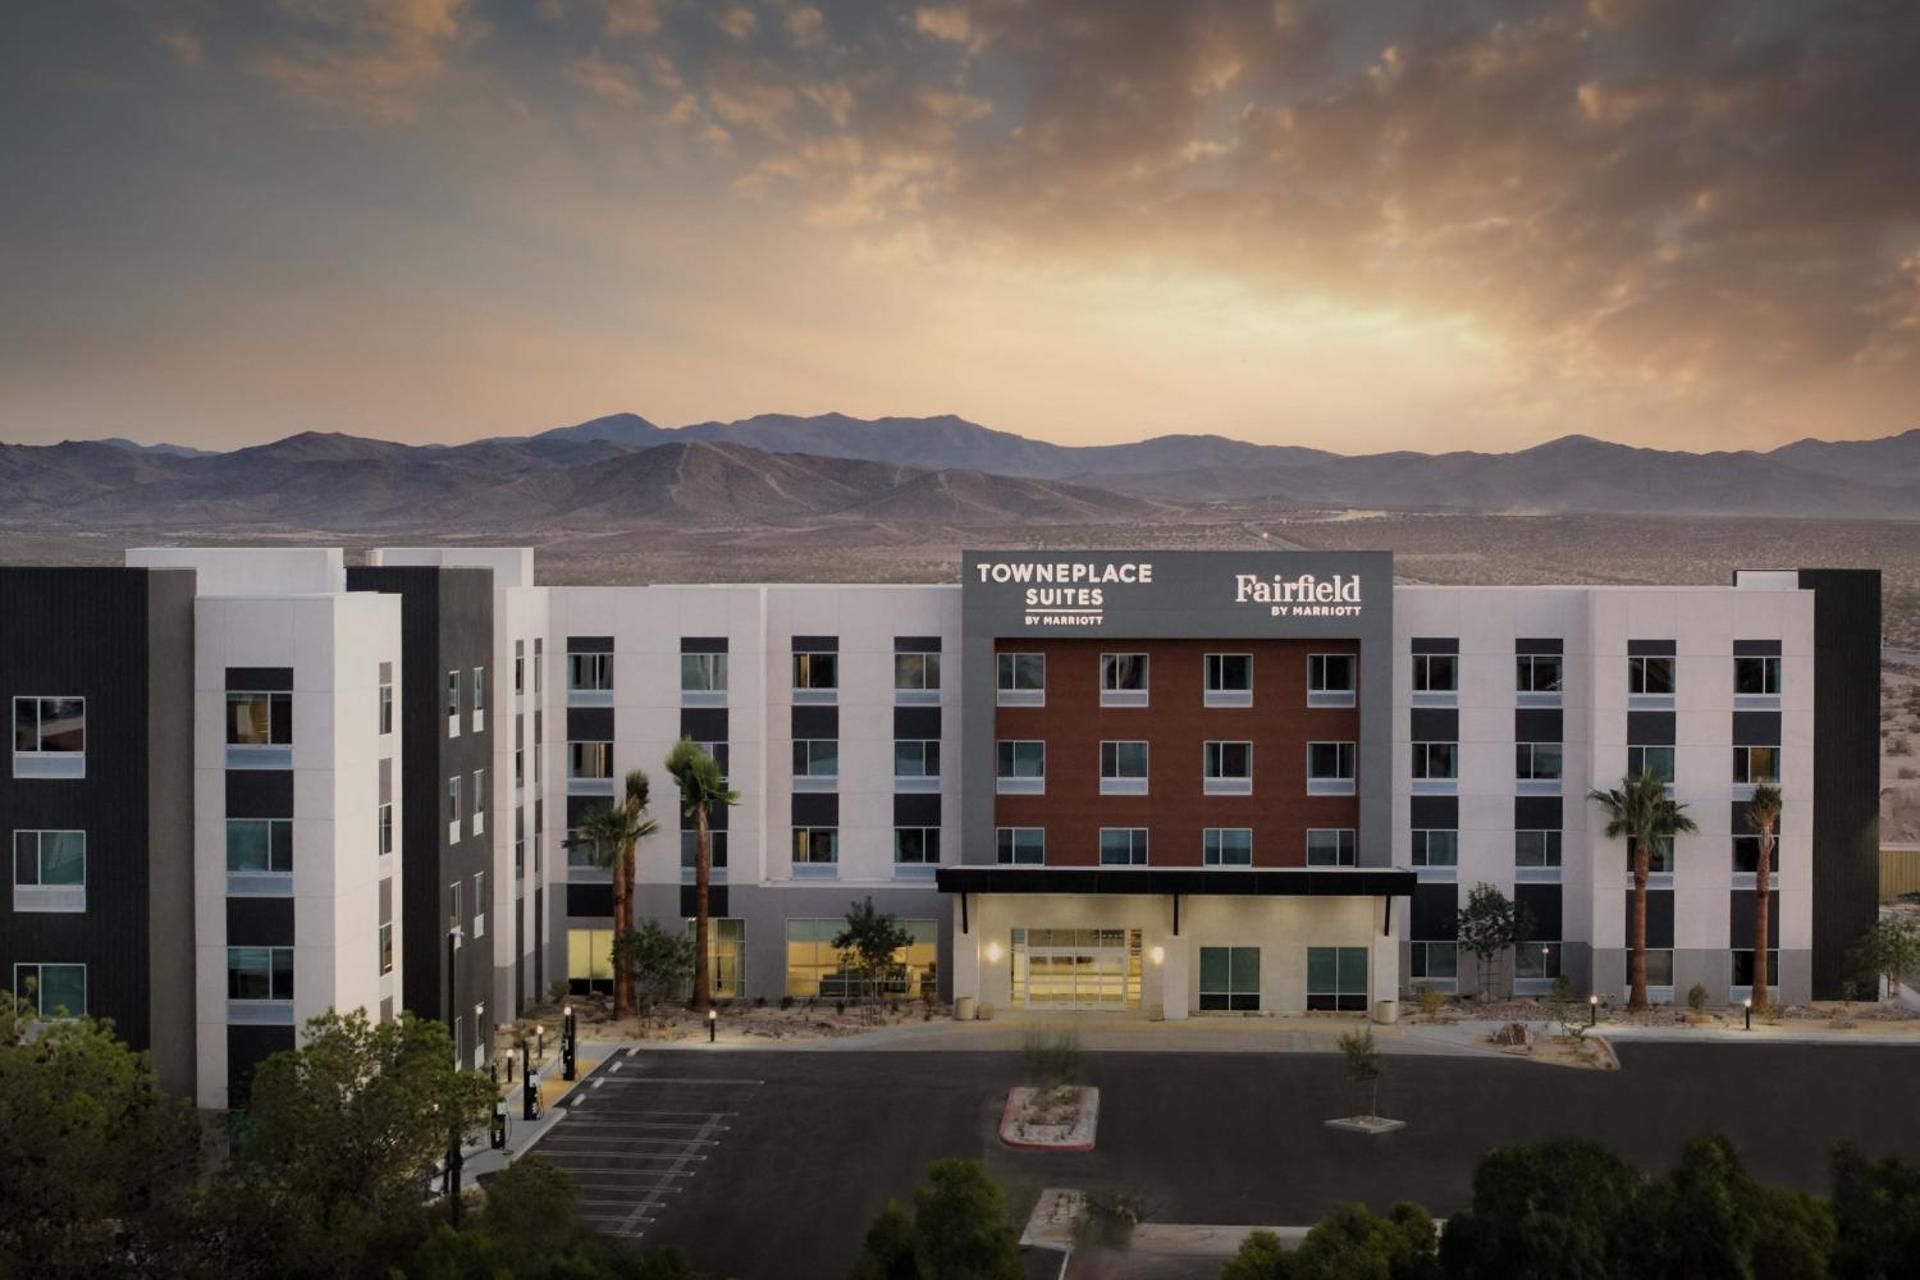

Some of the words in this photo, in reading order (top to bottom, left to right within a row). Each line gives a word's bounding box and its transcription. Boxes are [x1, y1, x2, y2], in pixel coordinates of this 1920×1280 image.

[977, 563, 1153, 584] TOWNEPLACE
[1025, 588, 1104, 606] SUITES
[1235, 574, 1362, 603] Fairfield
[1025, 616, 1040, 625] BY
[1043, 616, 1103, 625] MARRIOTT
[1271, 606, 1289, 617] BY
[1293, 606, 1362, 617] MARRIOTT
